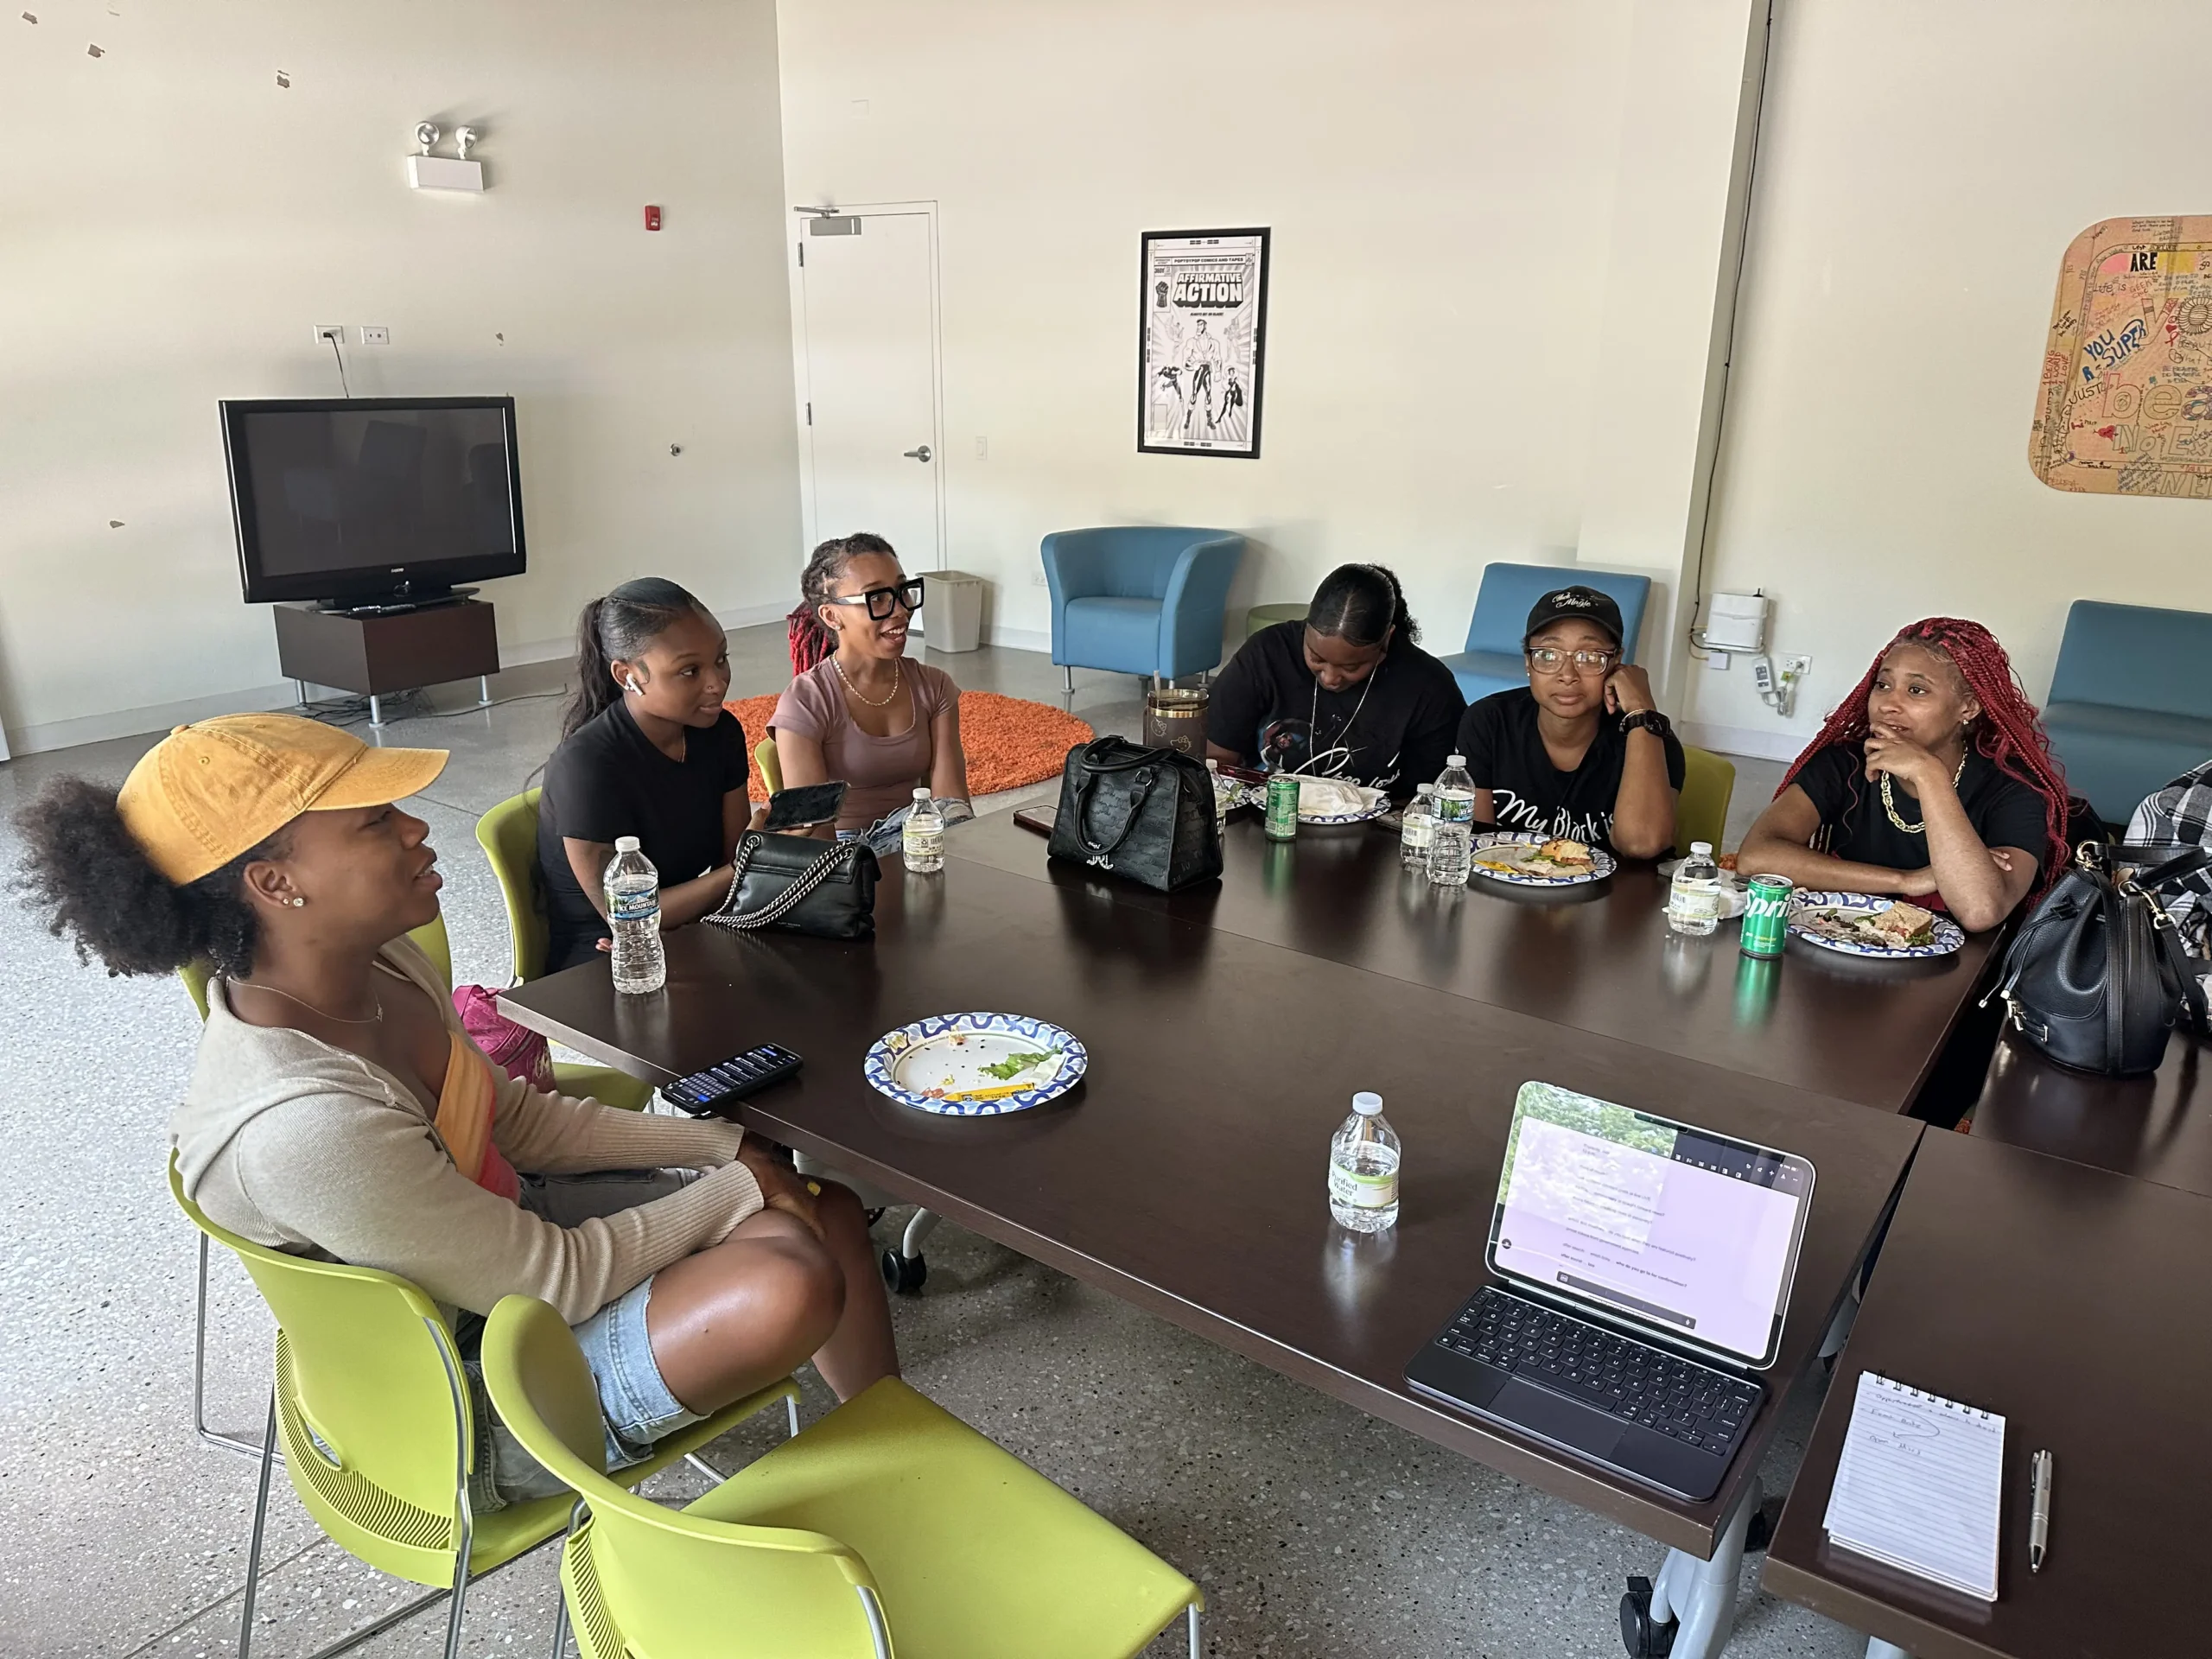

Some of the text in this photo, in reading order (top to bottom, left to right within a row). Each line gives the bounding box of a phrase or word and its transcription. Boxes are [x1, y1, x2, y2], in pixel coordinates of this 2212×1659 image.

[2130, 252, 2158, 272] ARE
[1178, 272, 1243, 283] AFFIRMATIVE
[1173, 283, 1243, 305] ACTION
[2083, 328, 2115, 361] YOU
[2044, 350, 2055, 380] BEING
[2069, 382, 2102, 404] JUST
[1492, 789, 1548, 835] My
[1553, 806, 1602, 843] Black
[1332, 1170, 1357, 1191] Purified
[1334, 1180, 1353, 1196] Water
